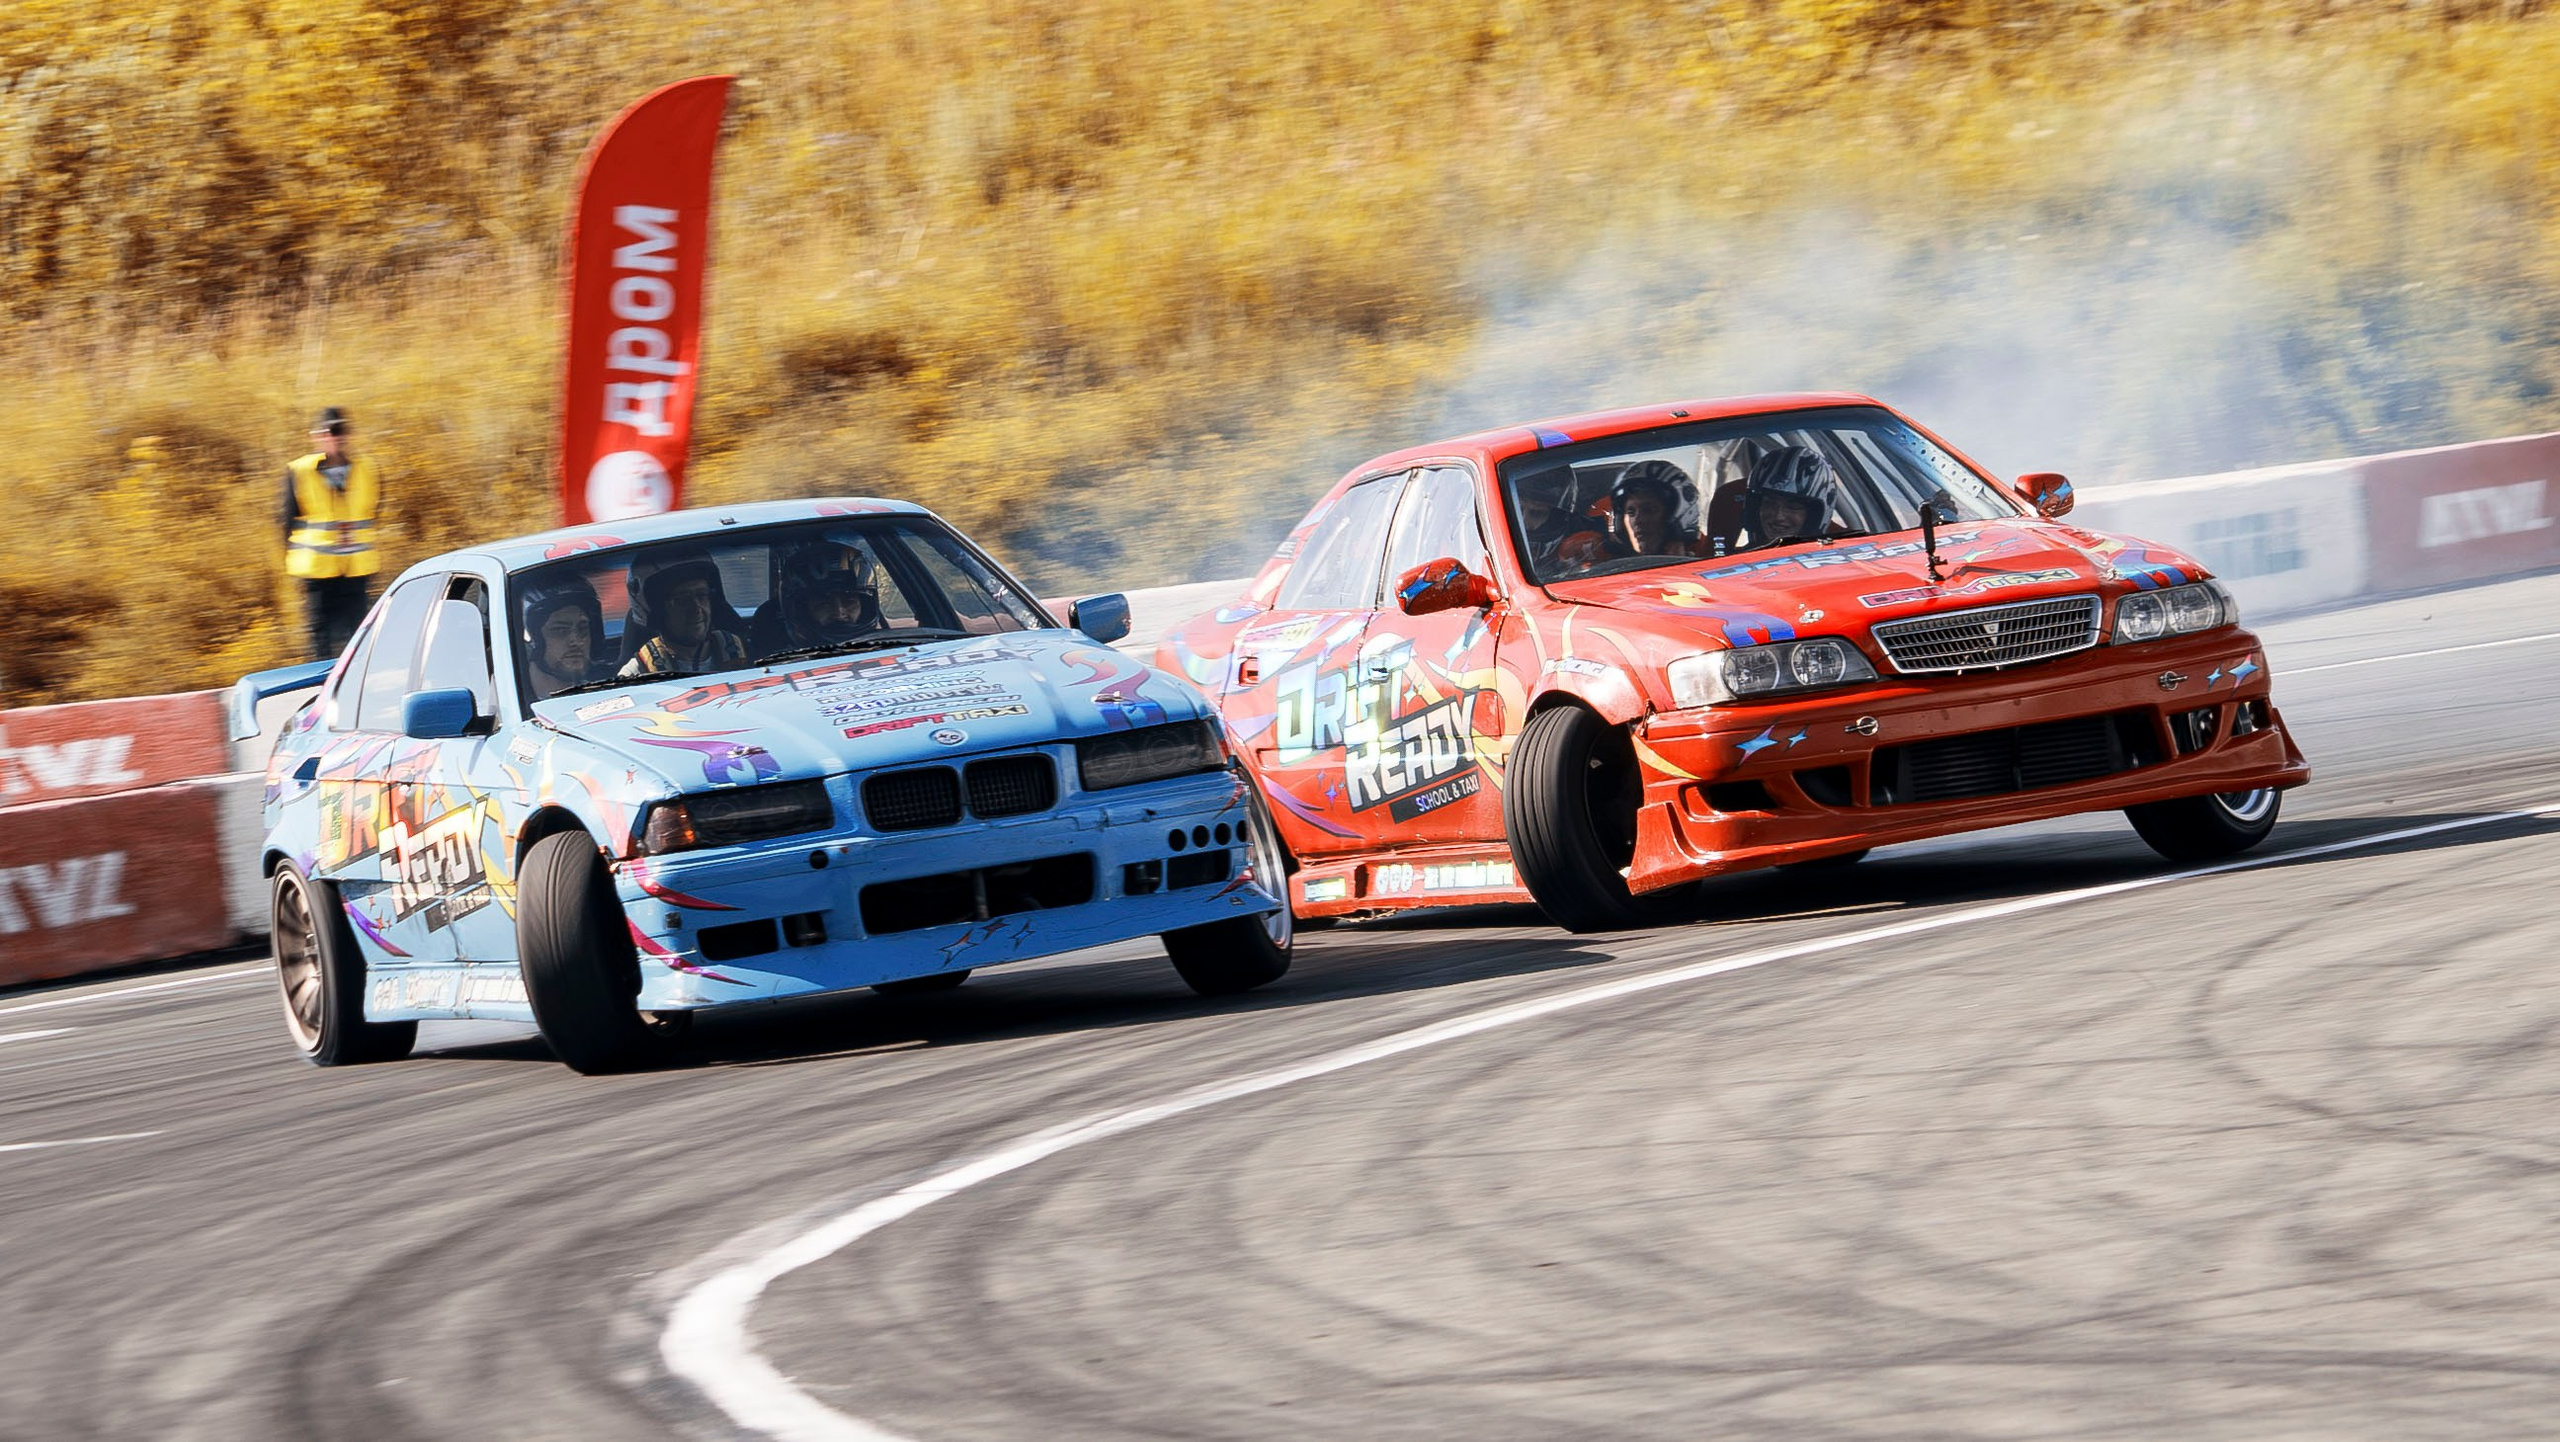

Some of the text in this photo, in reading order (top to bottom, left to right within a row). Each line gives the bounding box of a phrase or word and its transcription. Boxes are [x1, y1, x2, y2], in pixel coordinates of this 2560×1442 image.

[1698, 541, 1877, 579] DRIFT
[1800, 530, 1982, 569] READY
[656, 653, 906, 713] DRIFT
[793, 648, 1045, 691] READY
[1277, 639, 1415, 767] DRIFT
[1344, 694, 1477, 808] READY
[1415, 775, 1479, 812] SCHOOL & TAXI
